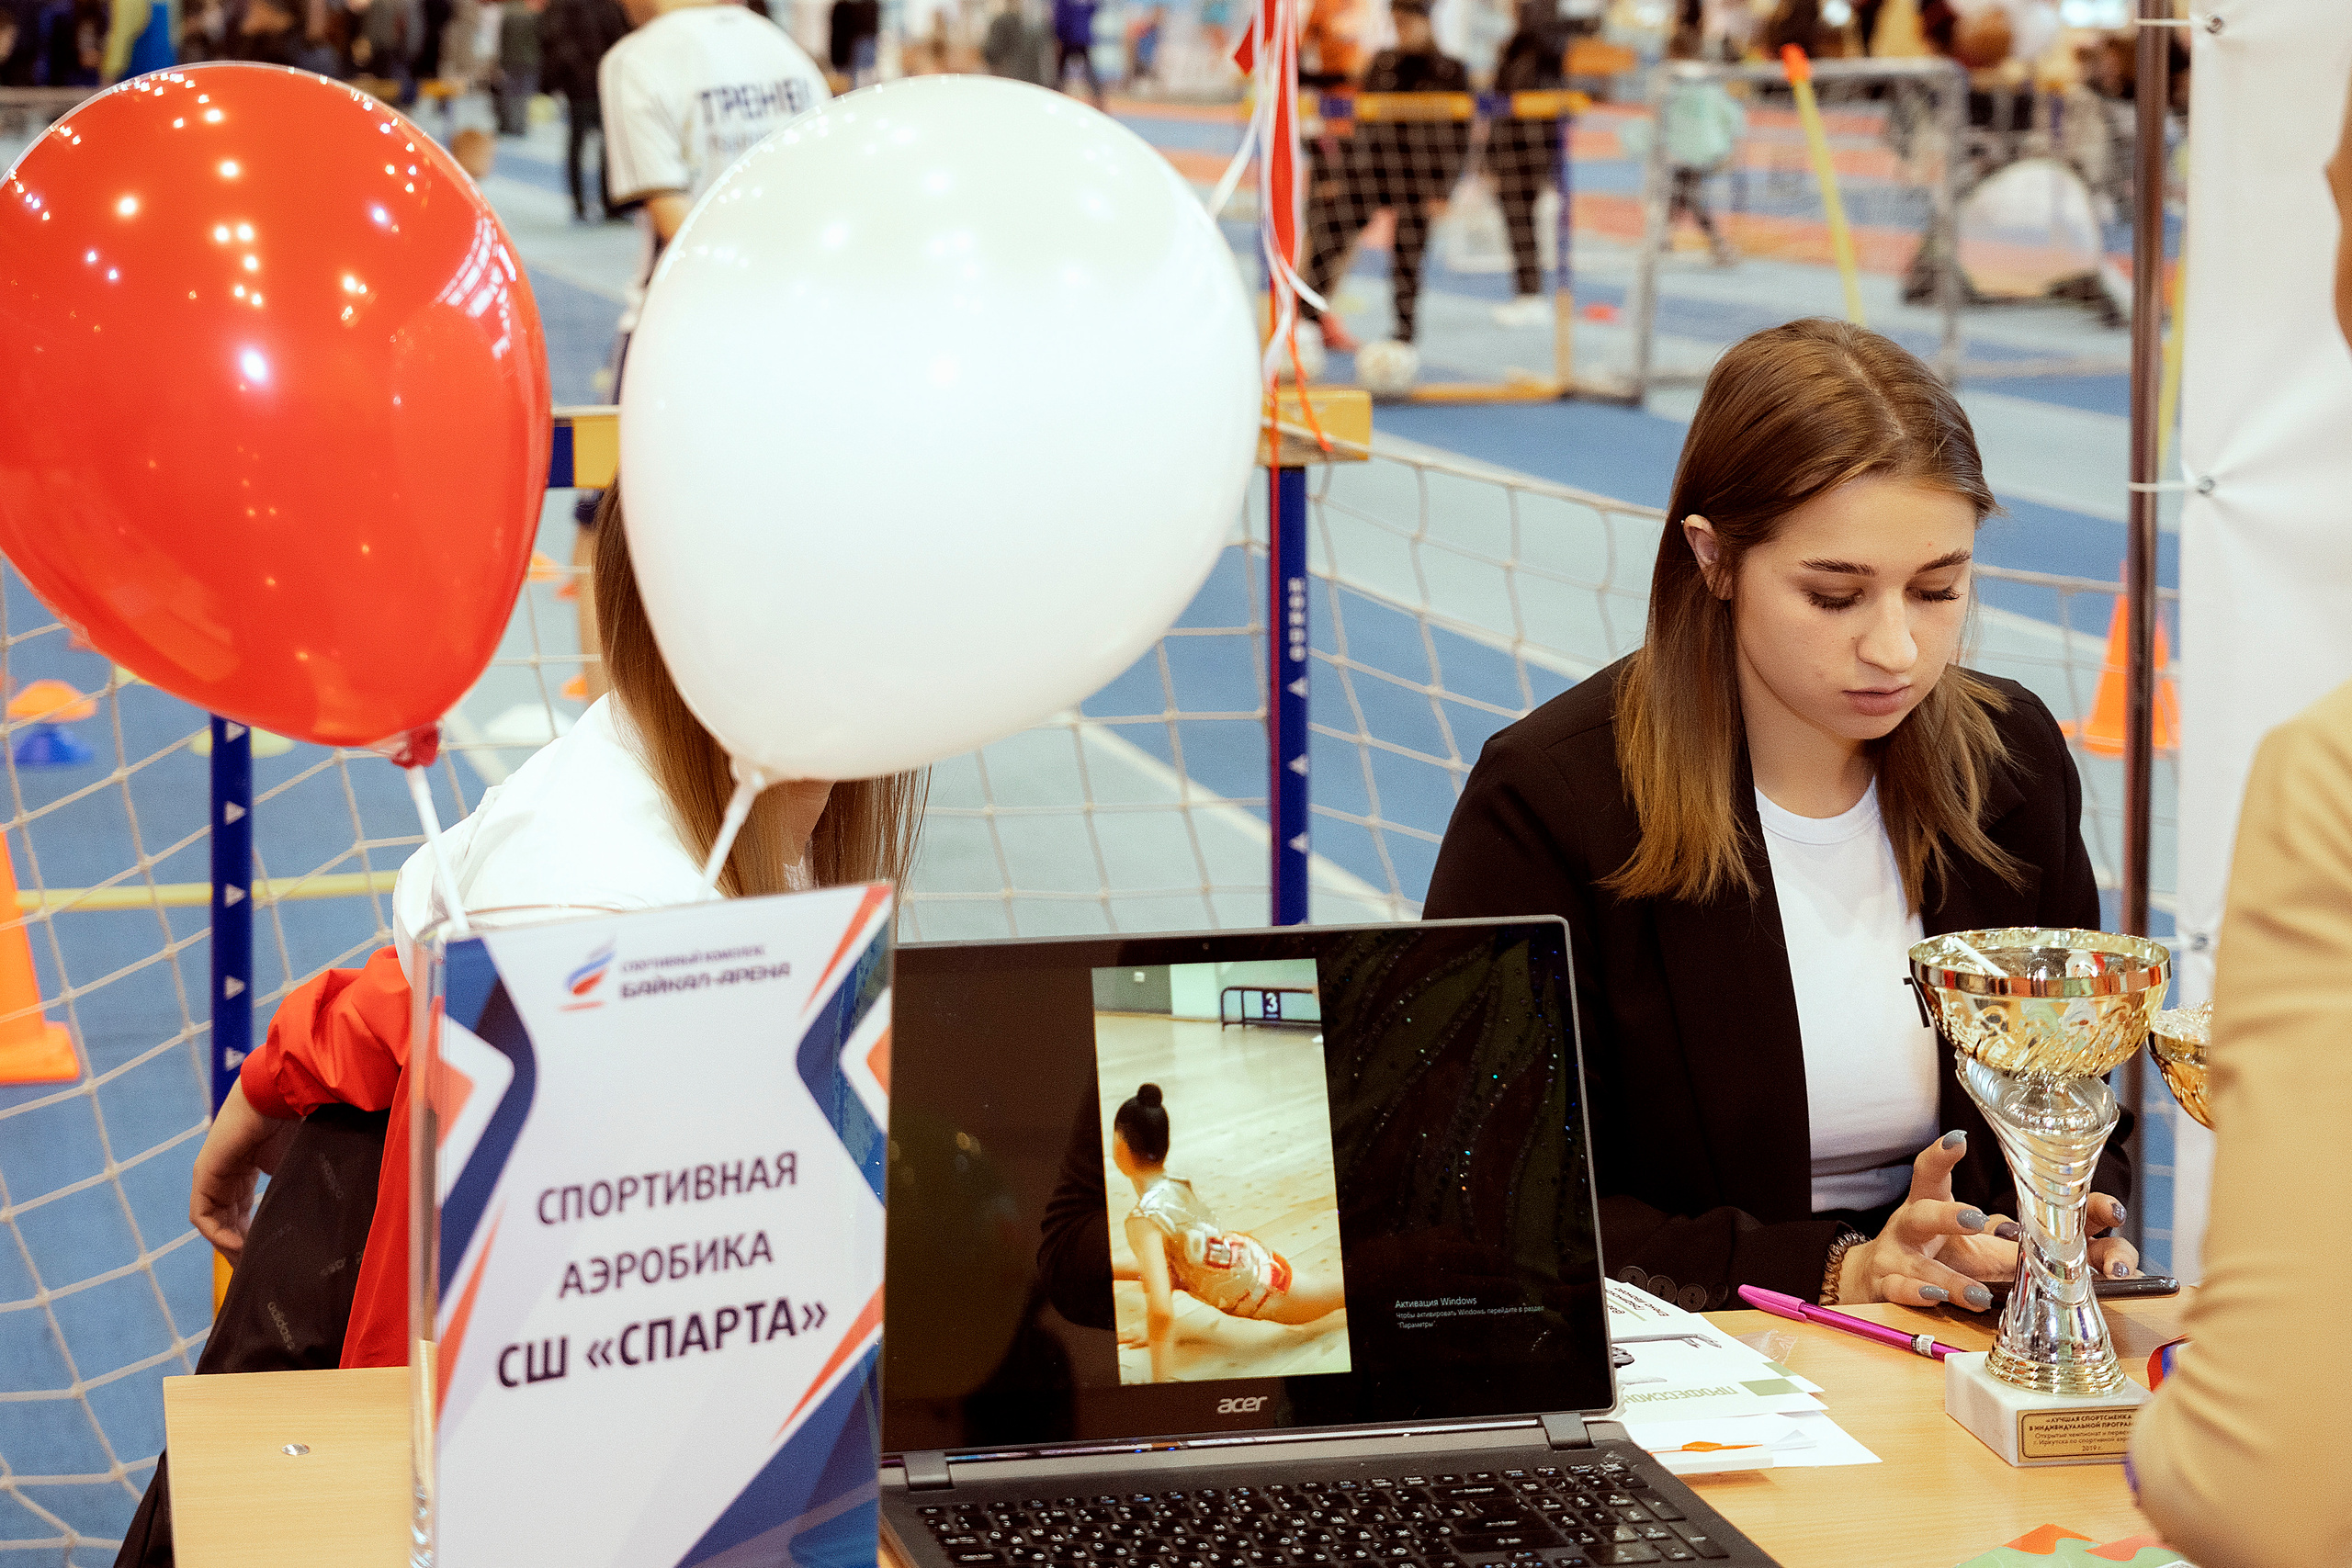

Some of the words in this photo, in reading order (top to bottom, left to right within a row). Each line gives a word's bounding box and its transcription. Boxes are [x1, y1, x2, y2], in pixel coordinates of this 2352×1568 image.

[1265, 992, 1279, 1013] 3
[536, 1150, 797, 1225] СПОРТИВНАЯ
[557, 1229, 775, 1298] АЭРОБИКА
[1395, 1300, 1439, 1308] Активация
[1440, 1296, 1477, 1306] Windows
[496, 1334, 568, 1388] СШ
[585, 1296, 828, 1366] «СПАРТА»
[1623, 1385, 1739, 1404] ПРОФЕССИОН
[1217, 1396, 1268, 1414] acer
[2034, 1422, 2101, 1431] ИНДИВИДУАЛЬНОЙ
